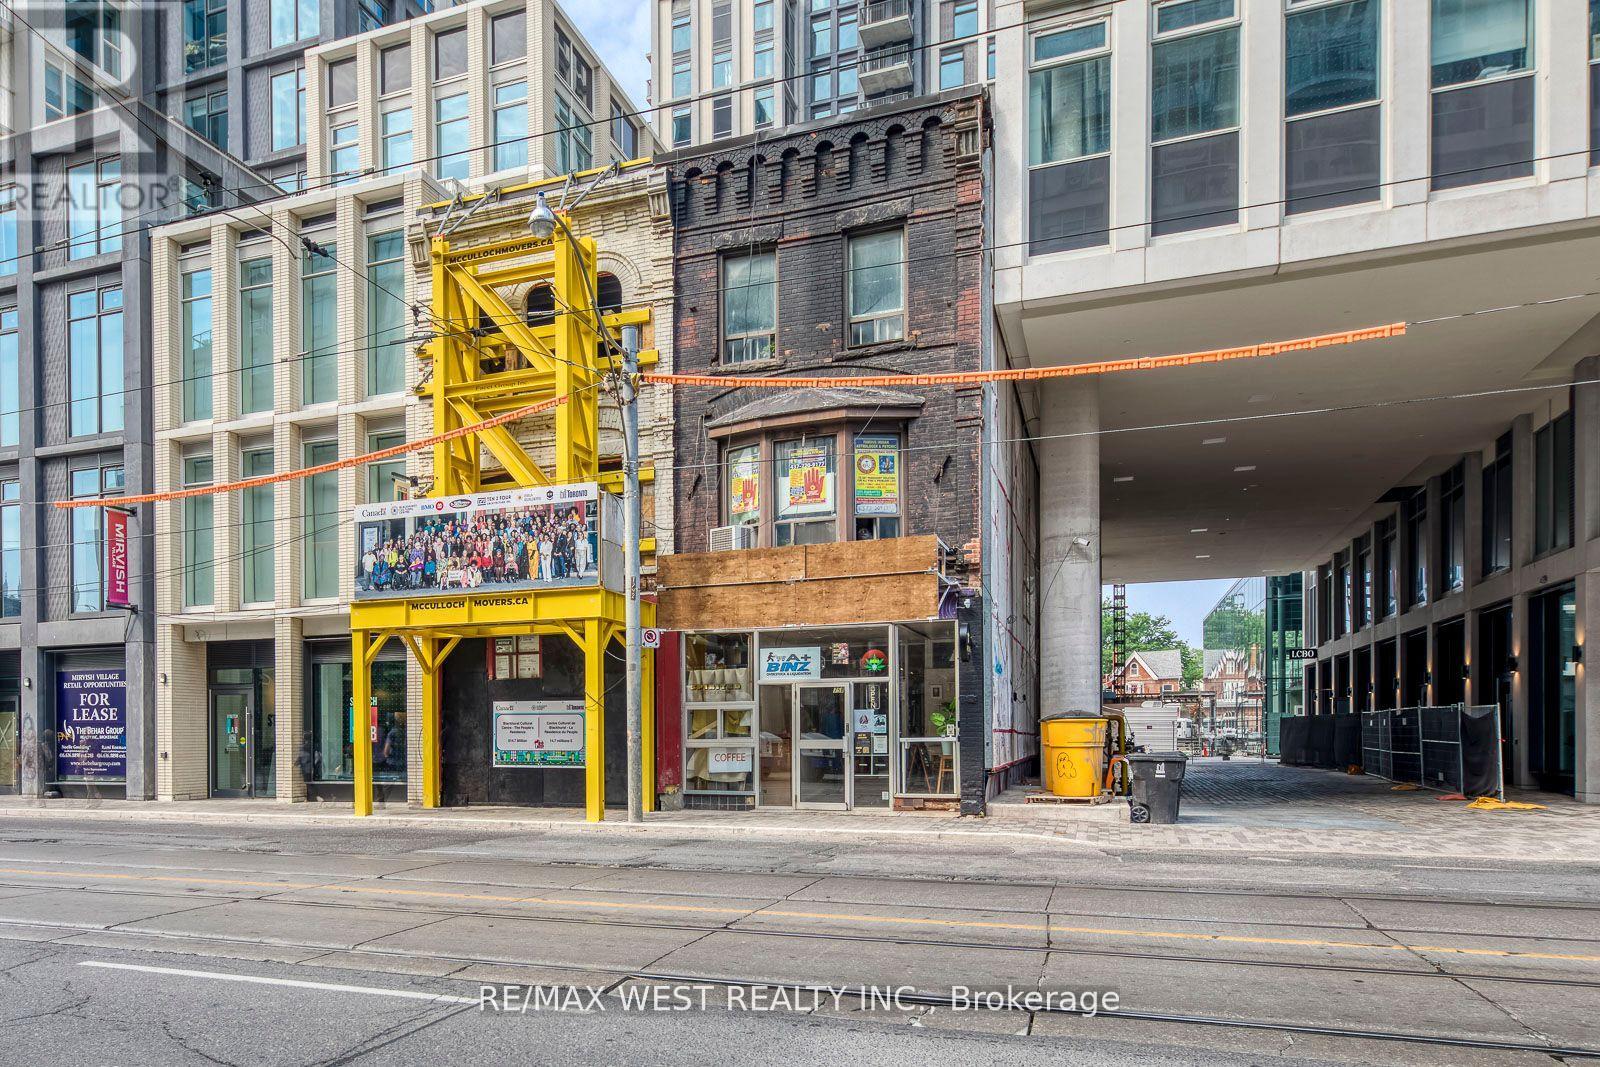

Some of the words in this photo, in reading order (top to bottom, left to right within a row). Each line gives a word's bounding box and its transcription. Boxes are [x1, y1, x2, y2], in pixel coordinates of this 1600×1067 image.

[450, 239, 553, 264] MCCULLOCHMOVERS.CA
[115, 523, 126, 593] MIRVISH
[411, 601, 465, 610] MCCULLOCH
[474, 597, 528, 607] MOVERS.CA
[1291, 650, 1314, 658] LCBO
[766, 661, 811, 672] BINZ
[80, 692, 110, 706] FOR
[72, 708, 118, 721] LEASE
[87, 726, 105, 735] BEHAR
[714, 752, 746, 762] COFFEE
